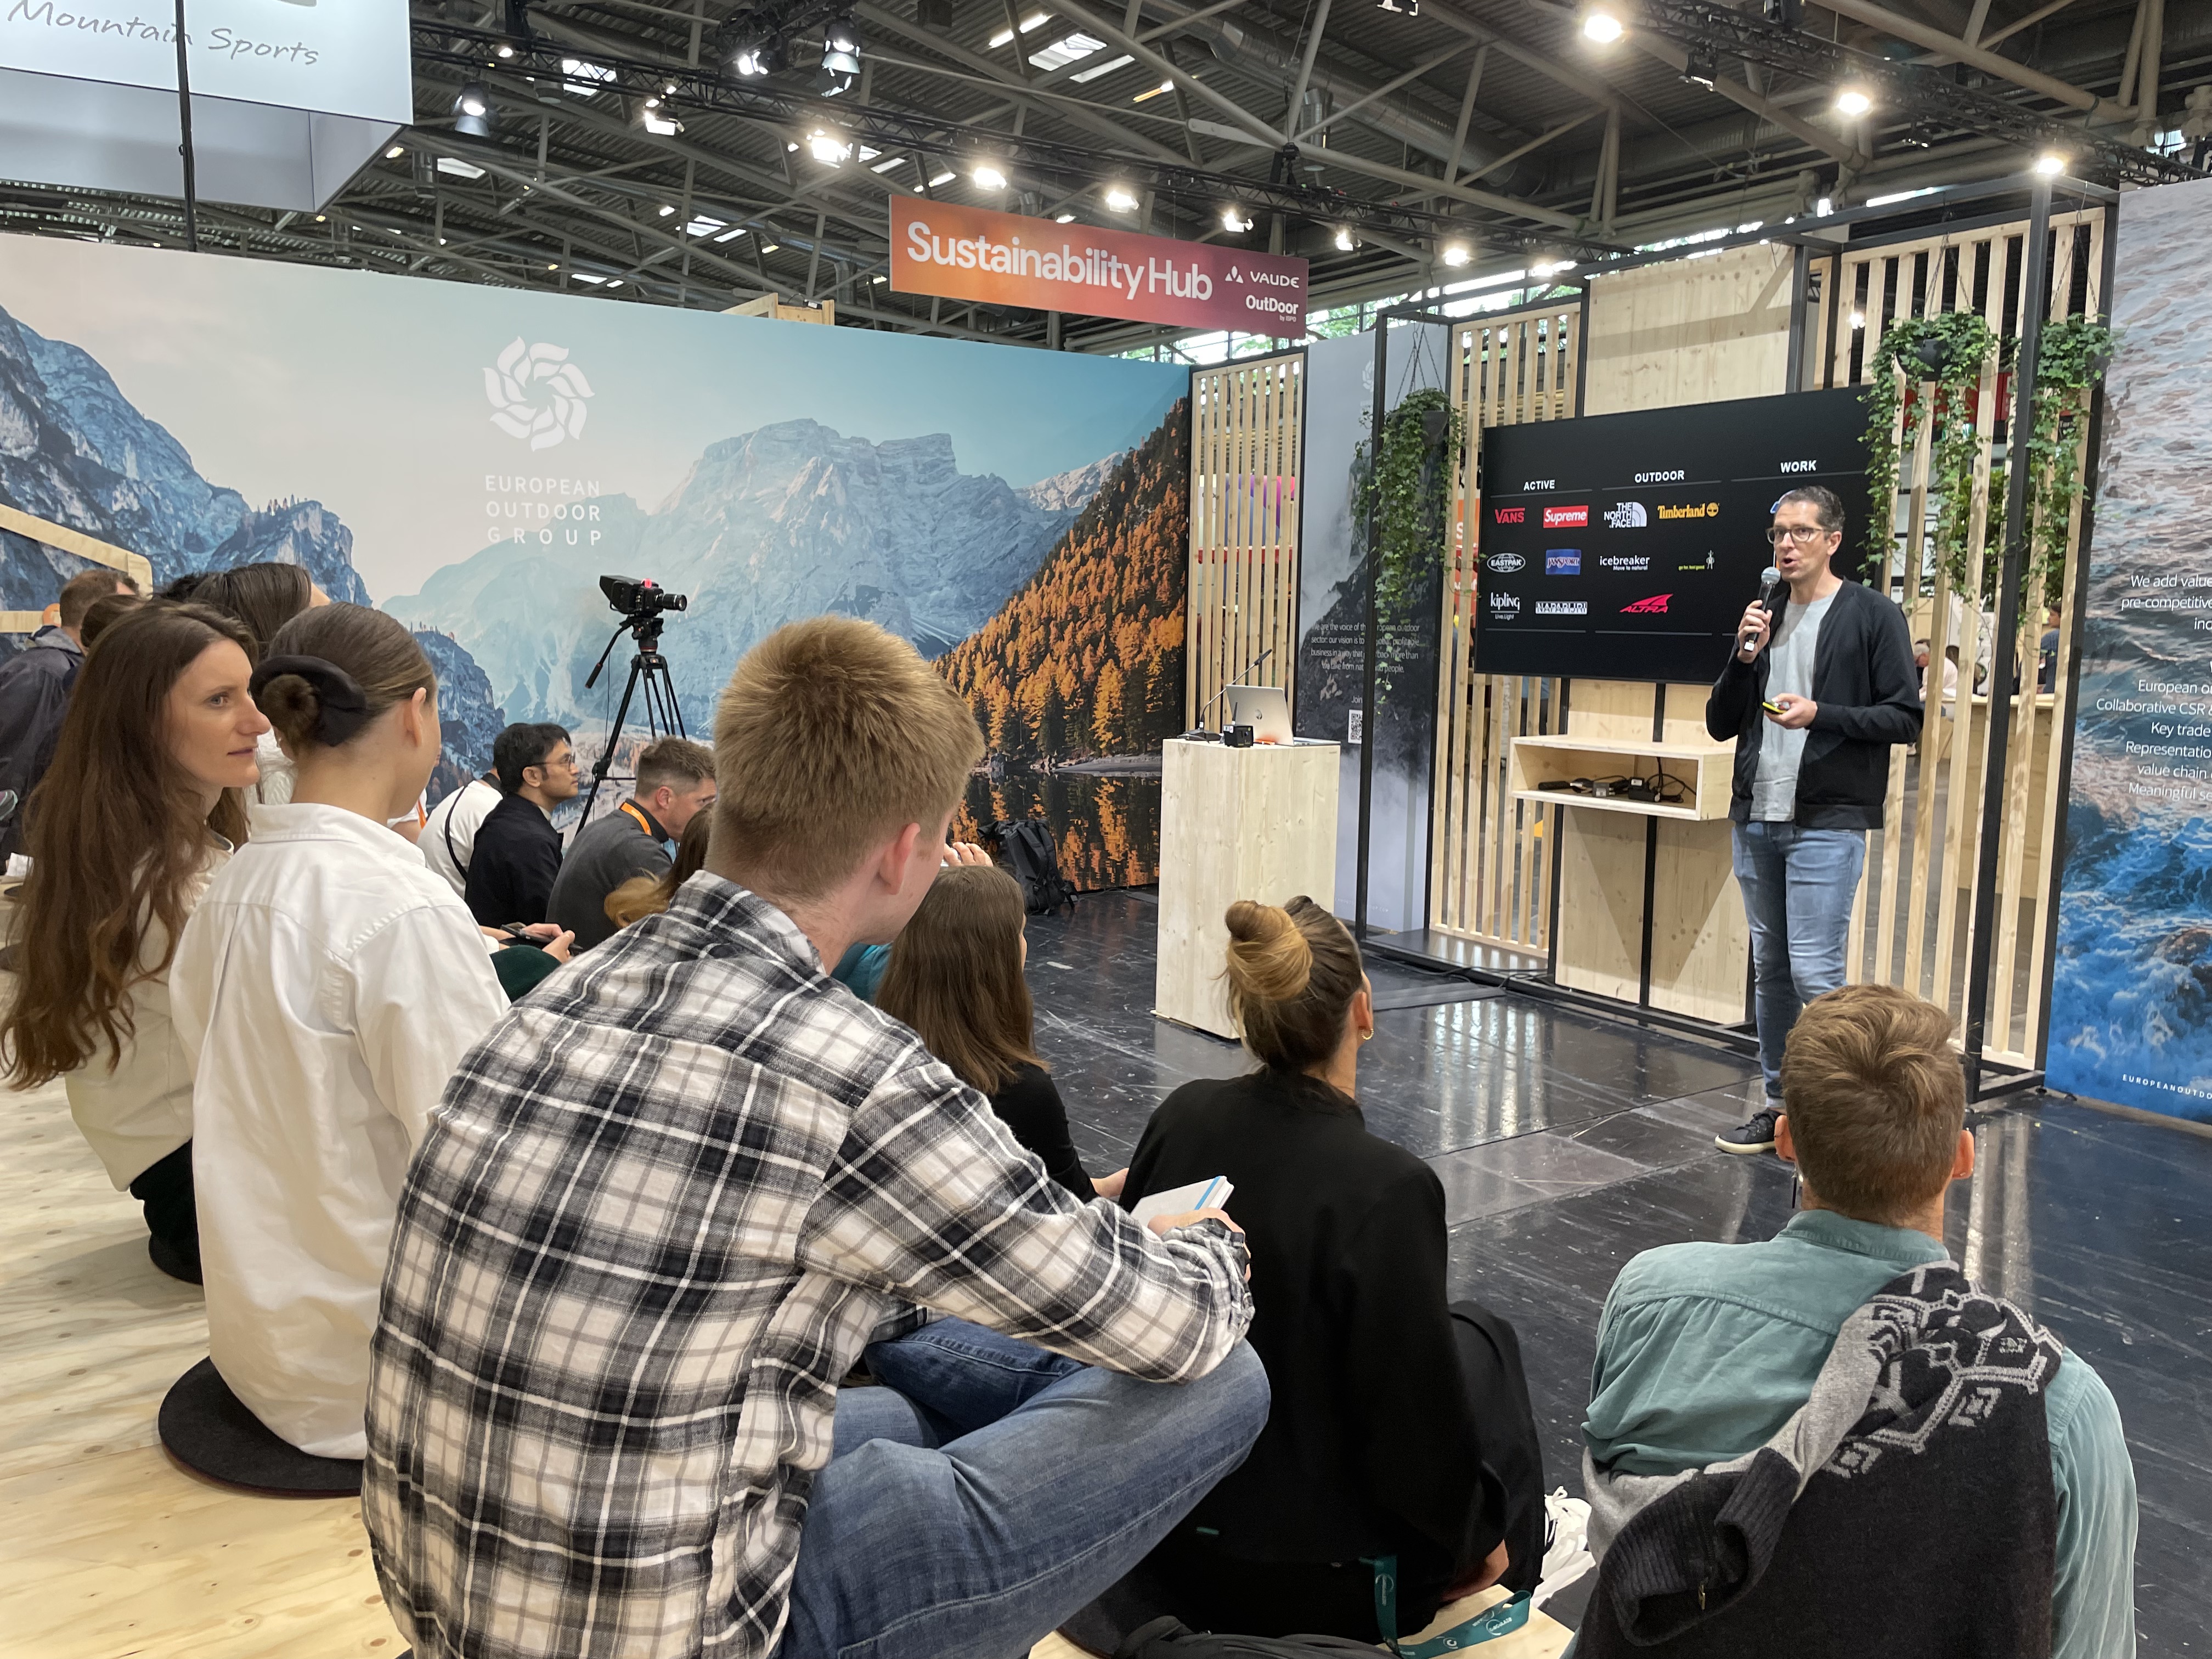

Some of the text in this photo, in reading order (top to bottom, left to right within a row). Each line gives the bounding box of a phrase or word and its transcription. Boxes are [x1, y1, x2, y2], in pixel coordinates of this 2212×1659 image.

[7, 0, 319, 65] Mountain Sports
[907, 221, 1213, 301] Sustainability Hub
[1250, 271, 1299, 288] VAUDE
[1246, 295, 1299, 314] OutDoor
[1780, 460, 1816, 473] WORK
[1635, 470, 1684, 483] OUTDOOR
[486, 475, 600, 496] EUROPEAN
[1523, 479, 1555, 491] ACTIVE
[486, 501, 601, 521] OUTDOOR
[1495, 507, 1525, 523] VANS
[1617, 503, 1632, 511] THE
[1657, 503, 1705, 519] Timberland
[1544, 509, 1587, 526] Supreme
[1604, 511, 1632, 521] NORTH
[1611, 519, 1632, 528] FACE
[488, 527, 601, 546] GROUP
[1491, 558, 1522, 567] EASTPAK
[1600, 555, 1650, 566] icebreaker
[2131, 575, 2150, 588] We
[2153, 574, 2177, 588] add
[1491, 592, 1520, 611] kipling
[1330, 622, 1339, 631] the
[1339, 623, 1353, 631] voice
[1353, 622, 1359, 631] of
[1338, 636, 1353, 644] vision
[1353, 636, 1358, 644] is
[1359, 636, 1365, 645] to
[1311, 648, 1332, 656] business
[1352, 649, 1363, 657] that
[1406, 649, 1419, 659] than
[1342, 661, 1355, 670] from
[2138, 679, 2197, 696] European
[1351, 695, 1363, 703] Join
[2096, 698, 2176, 714] Collaborative
[2180, 702, 2205, 715] CSR
[2151, 721, 2211, 738] Key trade
[2137, 763, 2207, 779] value chain
[2129, 782, 2196, 802] Meaningful
